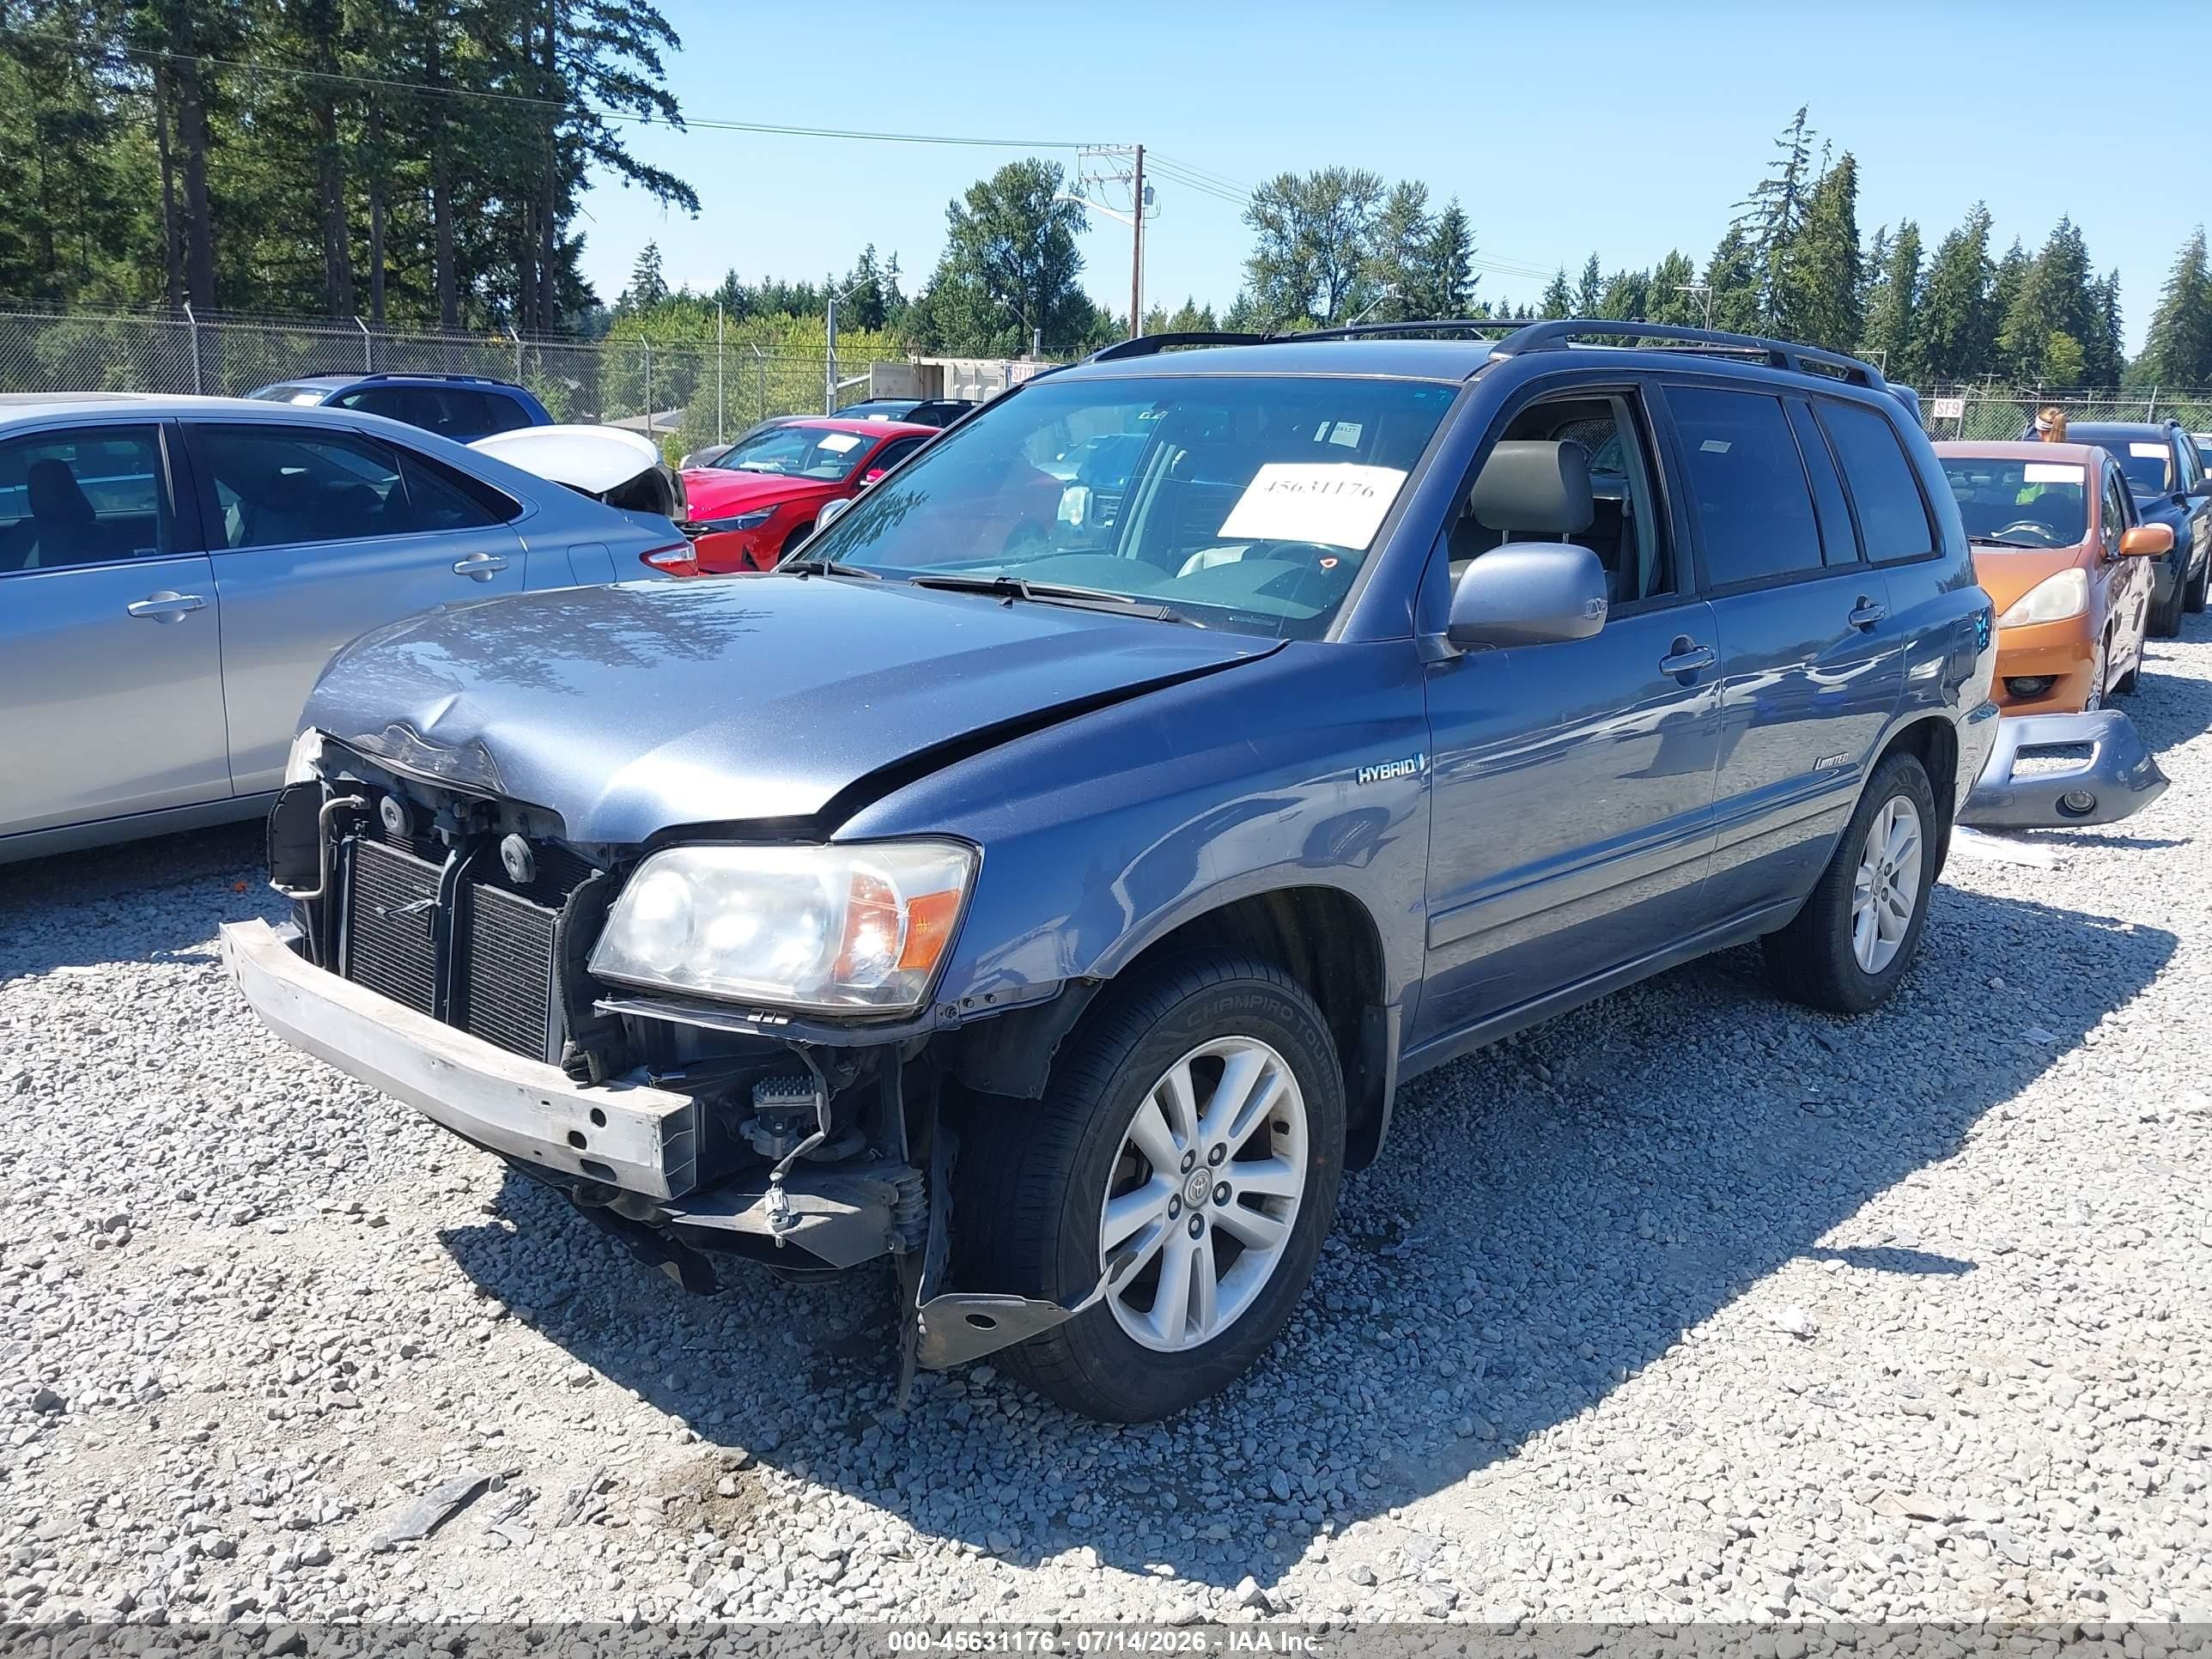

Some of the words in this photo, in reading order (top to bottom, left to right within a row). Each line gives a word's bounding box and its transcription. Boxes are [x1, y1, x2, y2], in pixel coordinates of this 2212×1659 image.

[1936, 401, 1960, 415] SF9
[1263, 480, 1375, 499] 45631176
[1358, 758, 1416, 785] HYBRID
[1186, 994, 1294, 1029] CHAMPIRO
